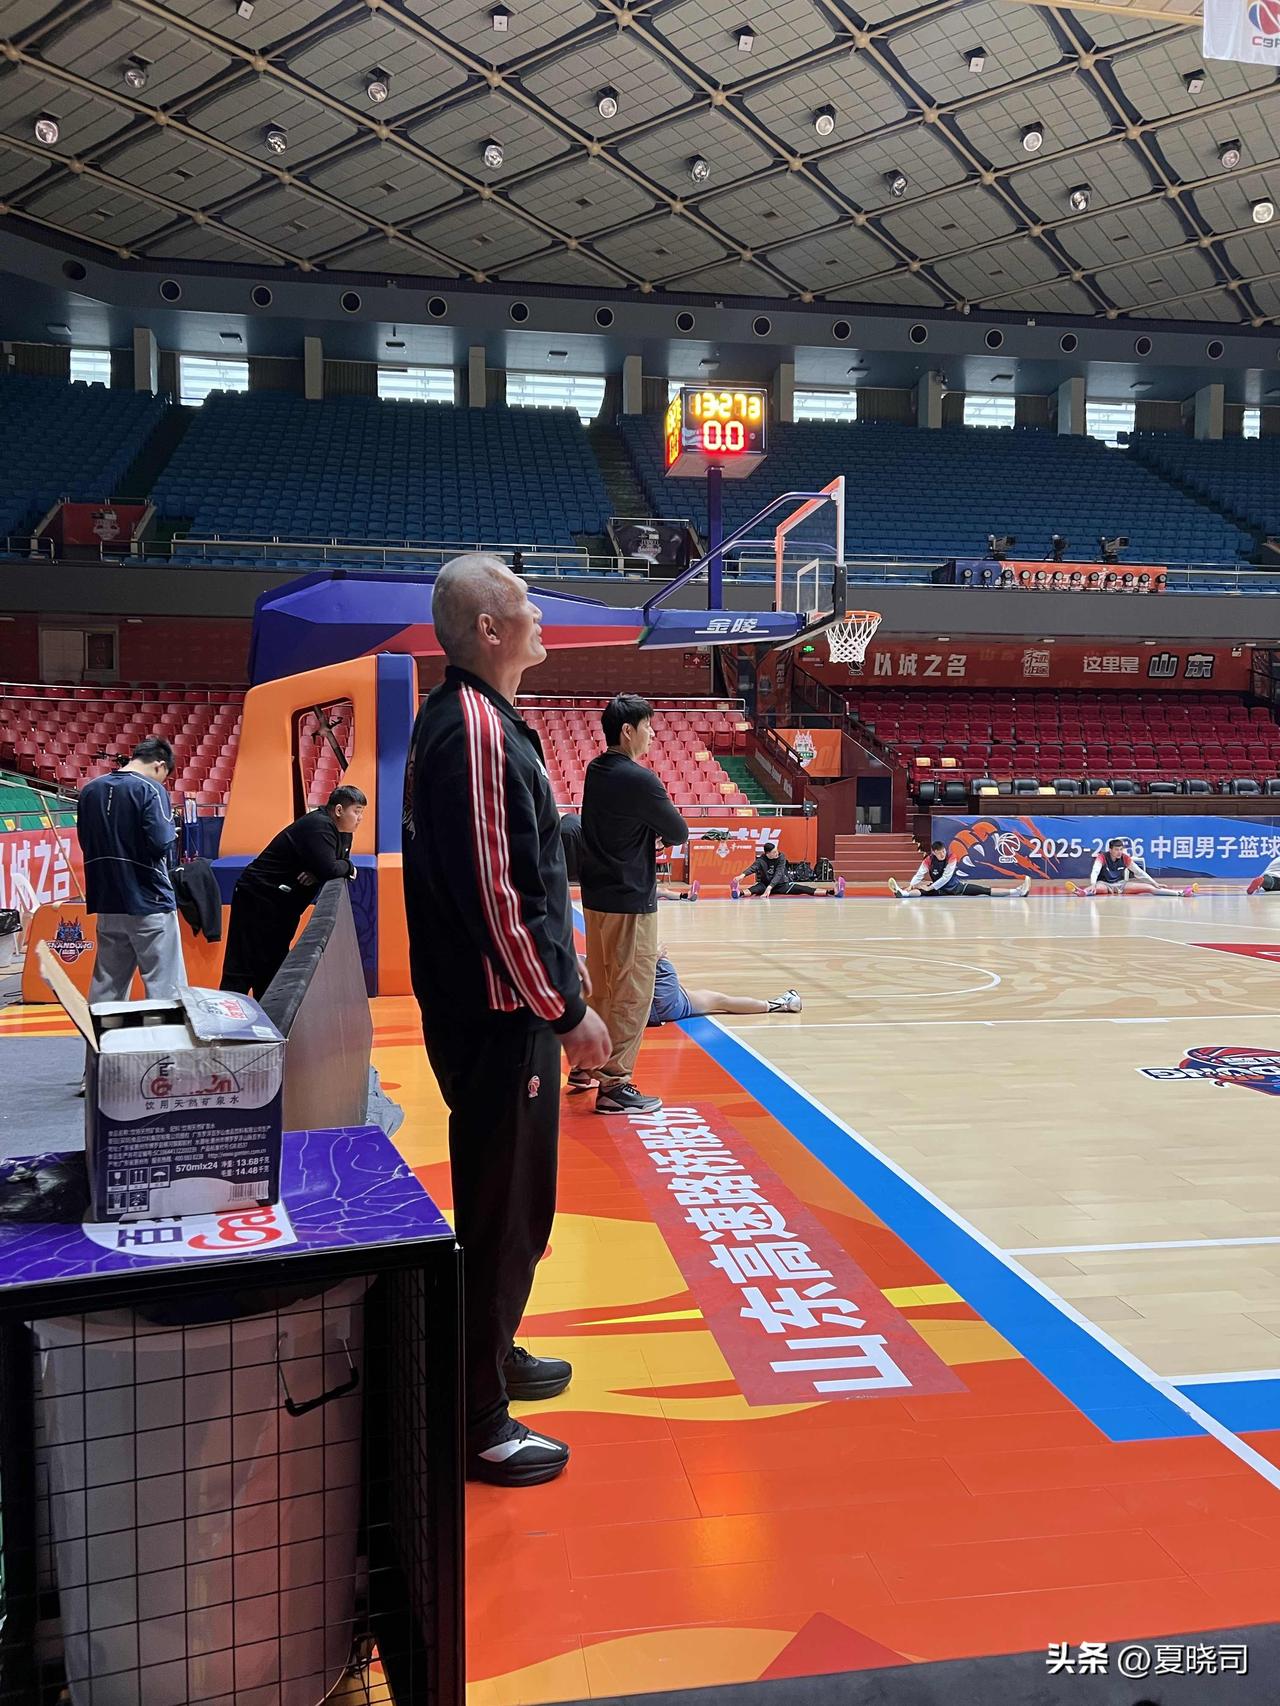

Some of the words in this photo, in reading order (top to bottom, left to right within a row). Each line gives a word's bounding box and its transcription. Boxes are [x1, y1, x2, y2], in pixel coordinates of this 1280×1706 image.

[703, 420, 745, 451] 0.0
[873, 653, 967, 676] 以城之名
[1083, 655, 1139, 674] 这里是
[1147, 653, 1215, 678] 山东
[1029, 838, 1144, 858] 2025-26
[1150, 835, 1280, 859] 中国男子篮球
[145, 1095, 240, 1110] 饮用天然矿泉水
